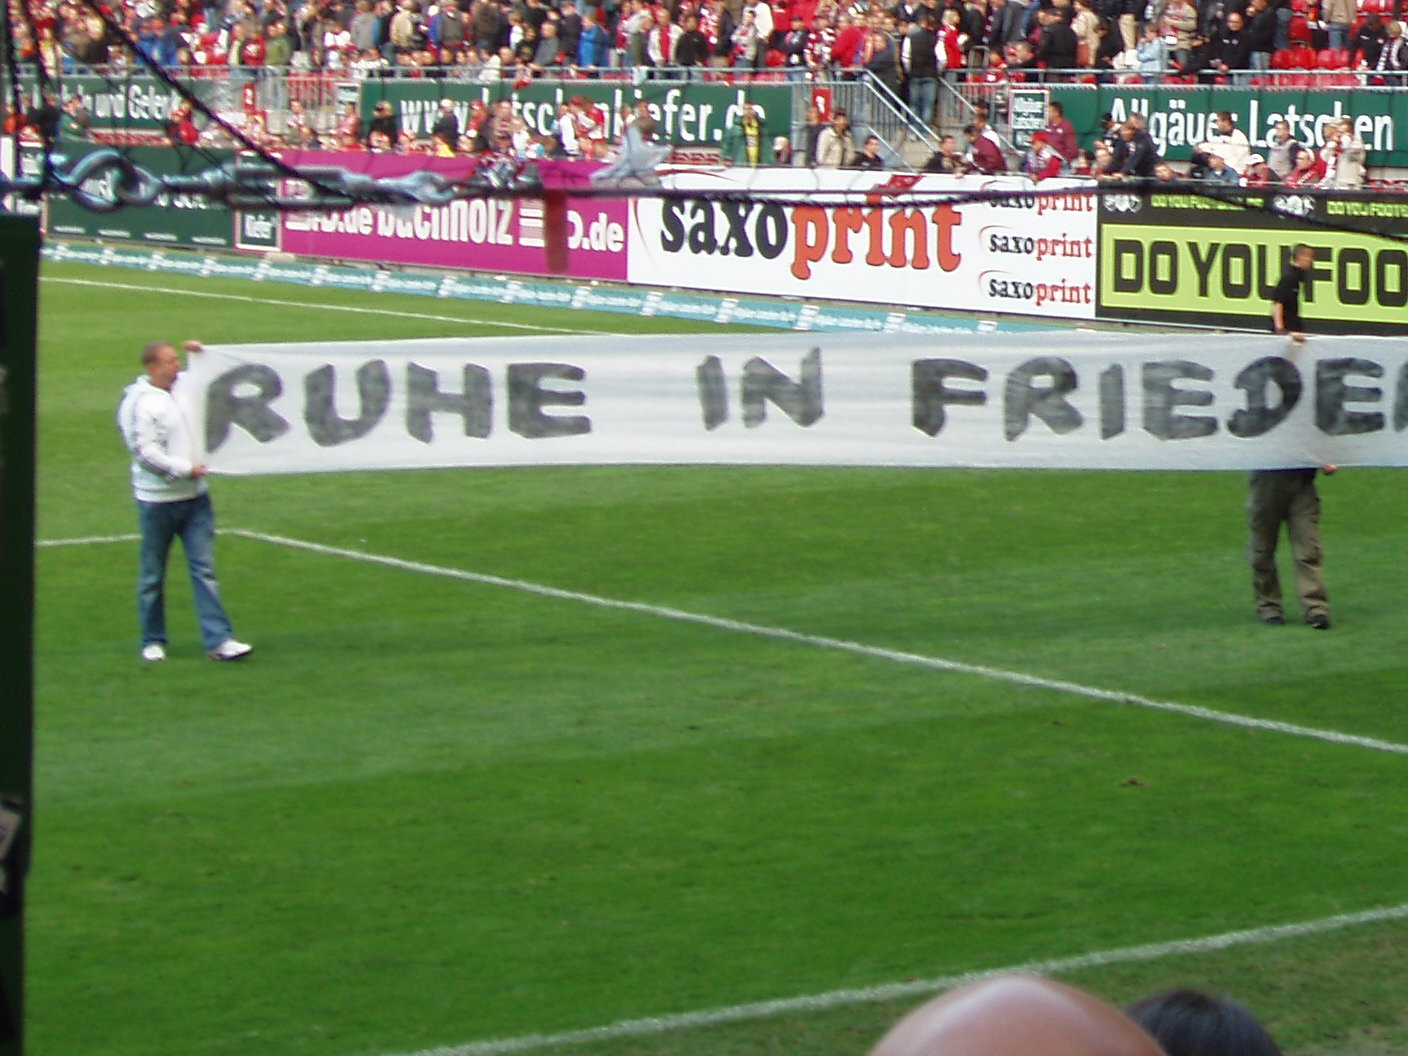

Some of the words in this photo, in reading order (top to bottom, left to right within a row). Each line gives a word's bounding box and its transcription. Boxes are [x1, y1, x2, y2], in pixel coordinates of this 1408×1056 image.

[660, 193, 962, 280] saxoprint
[988, 231, 1094, 259] saxoprint
[988, 275, 1093, 305] saxoprint
[205, 358, 593, 453] RUHE
[696, 347, 824, 432] IN
